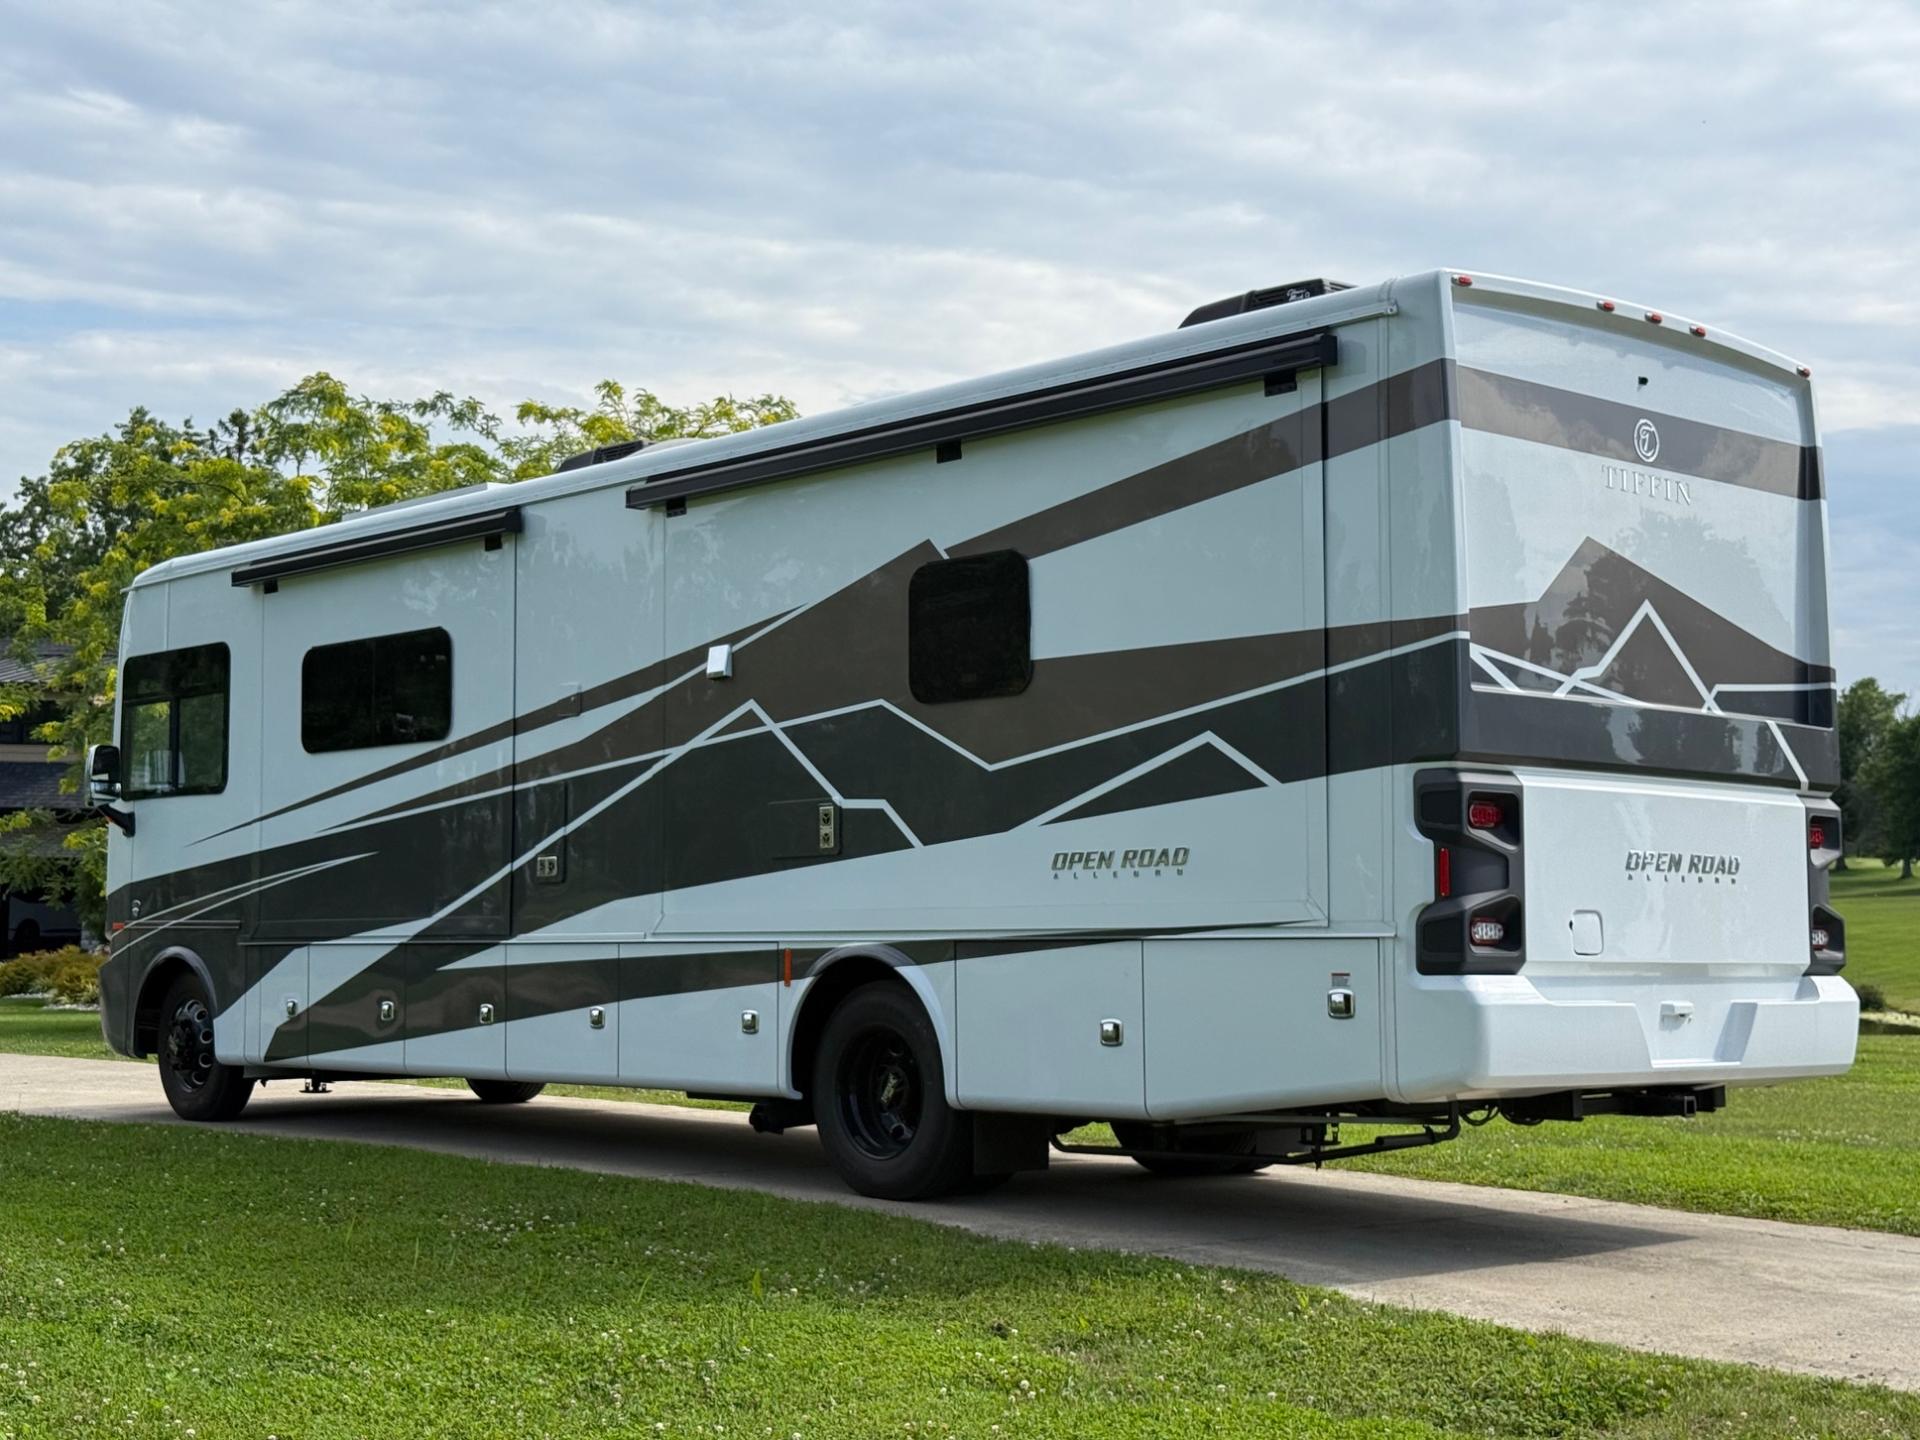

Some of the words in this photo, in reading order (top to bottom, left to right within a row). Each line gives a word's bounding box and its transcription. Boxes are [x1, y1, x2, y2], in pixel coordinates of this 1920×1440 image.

[1601, 464, 1691, 506] TIFFIN
[1051, 850, 1115, 871] OPEN
[1120, 847, 1190, 869] ROAD
[1625, 851, 1683, 872] OPEN
[1687, 853, 1740, 875] ROAD
